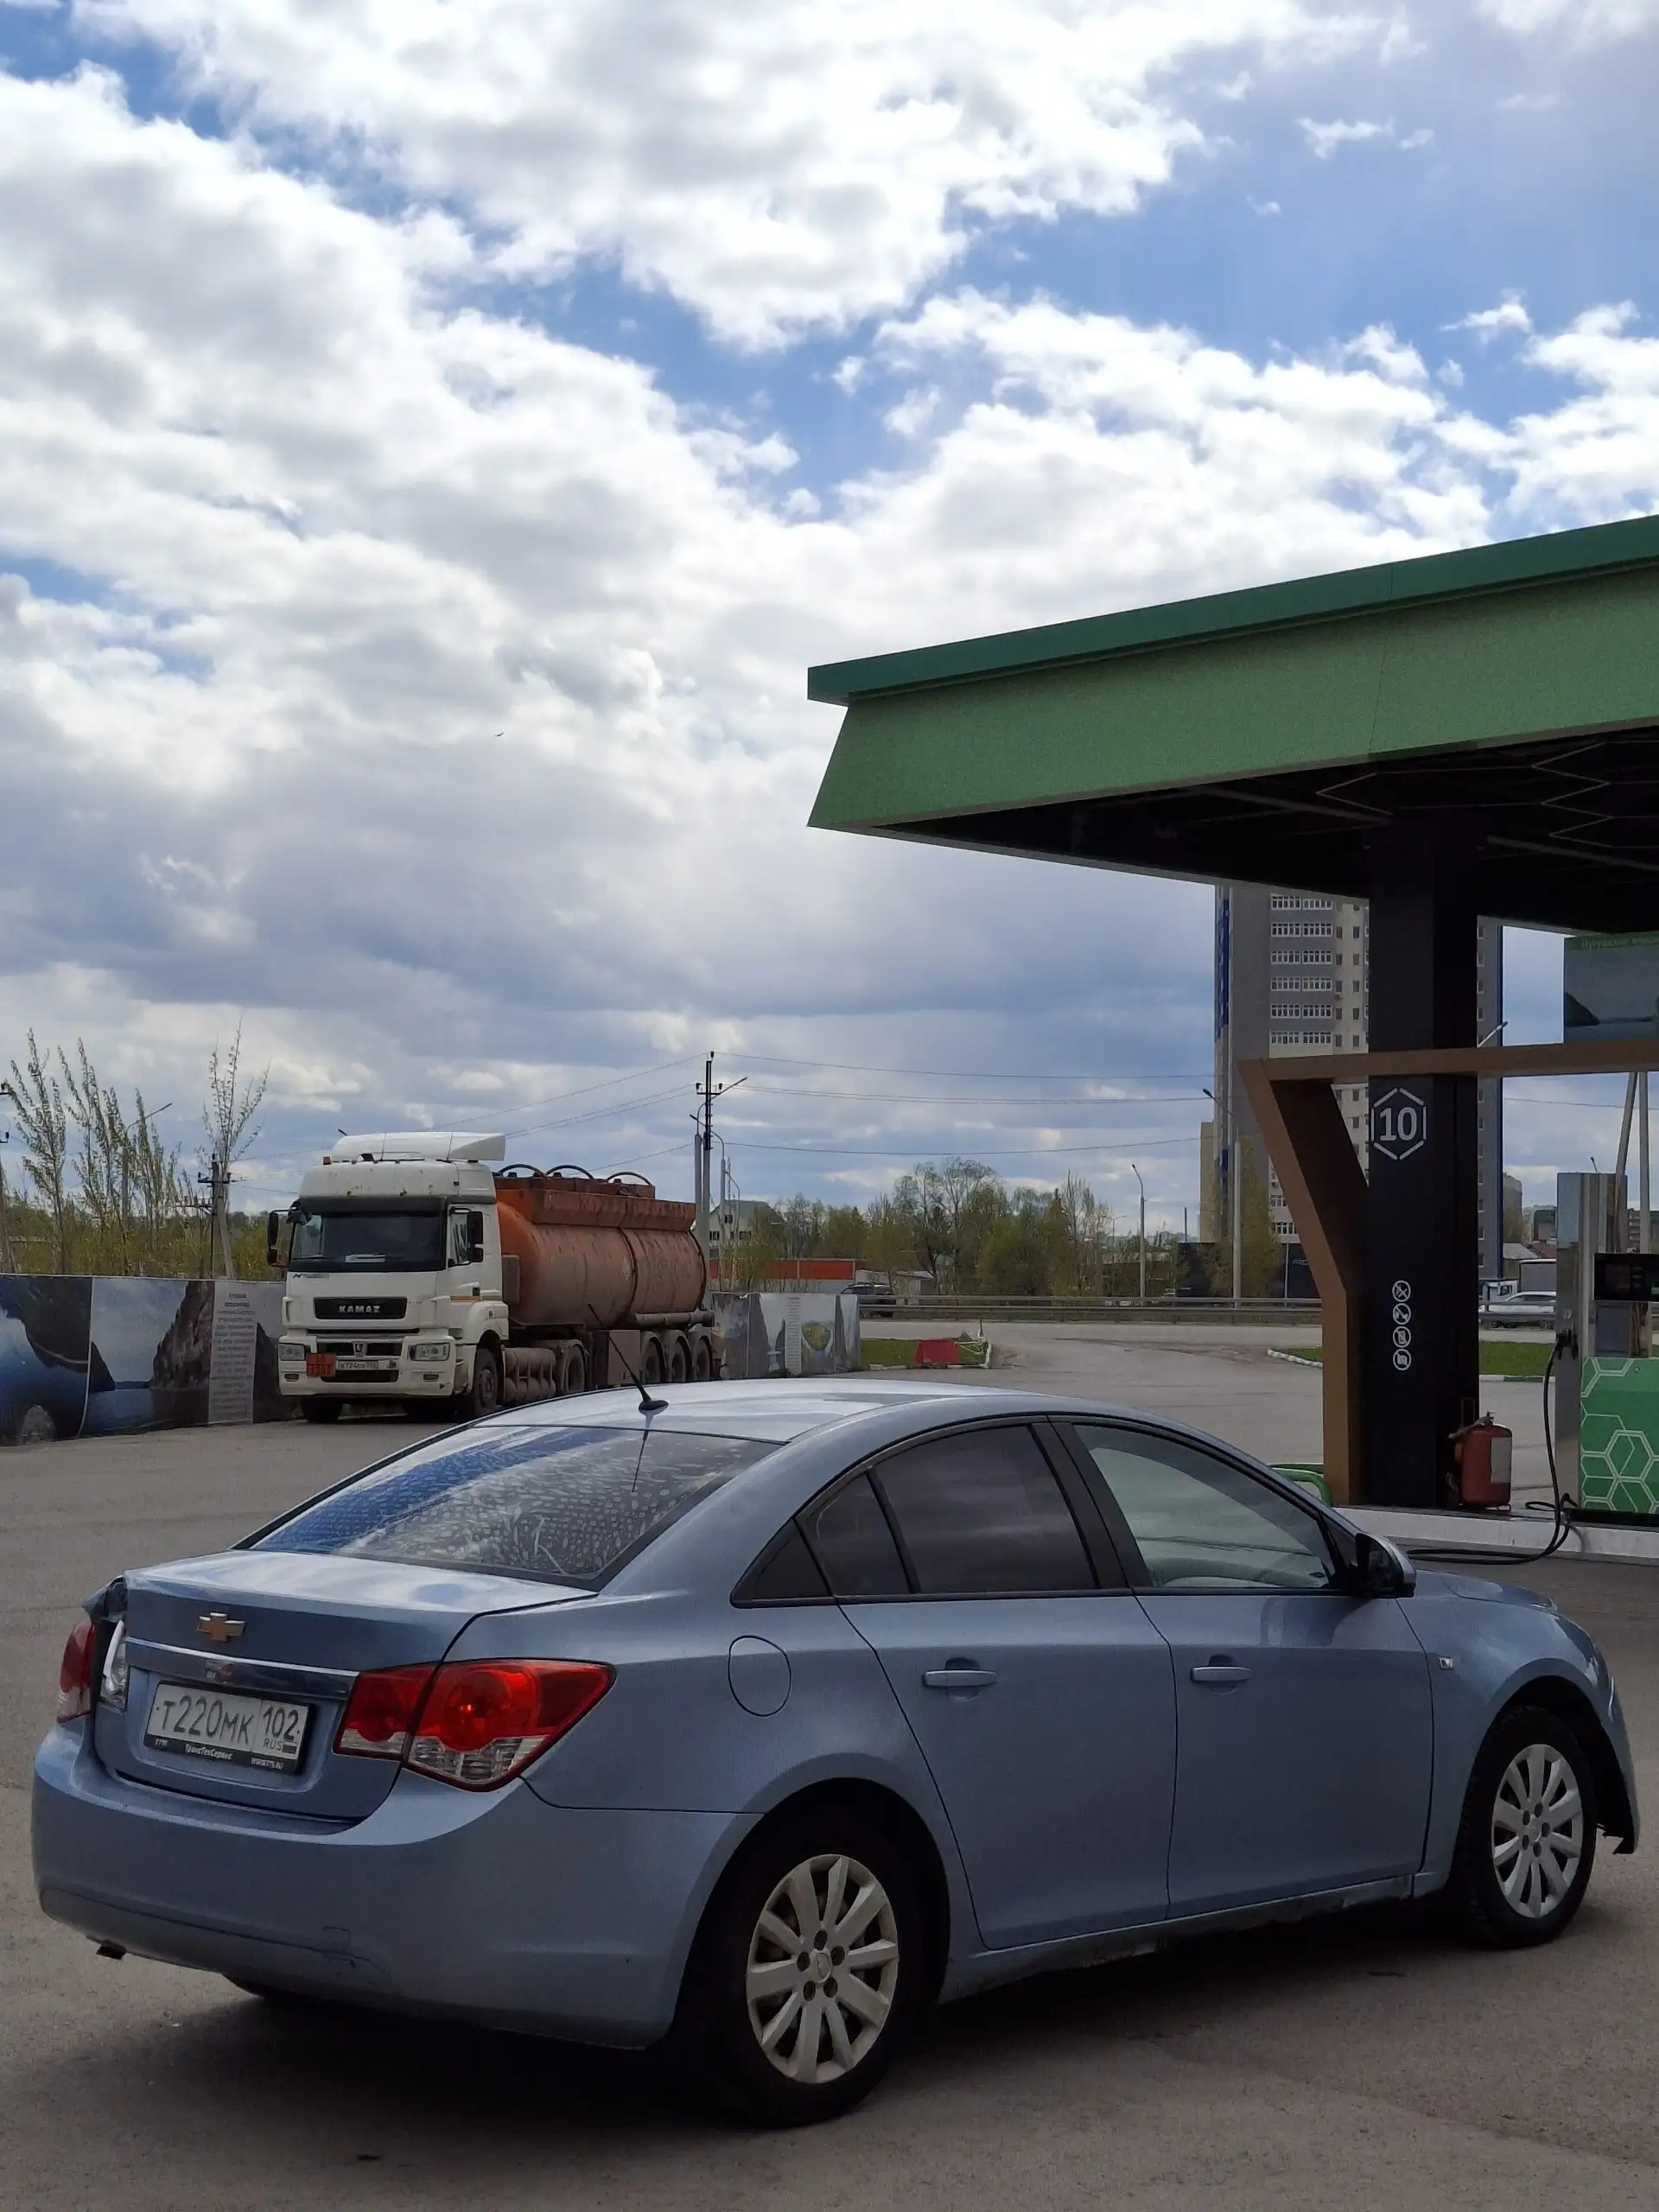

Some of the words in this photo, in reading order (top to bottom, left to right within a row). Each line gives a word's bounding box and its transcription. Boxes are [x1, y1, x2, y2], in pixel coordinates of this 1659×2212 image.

[1379, 1107, 1417, 1141] 10
[339, 1305, 381, 1313] KAMAZ
[263, 1707, 299, 1741] 102
[264, 1738, 283, 1751] RUS
